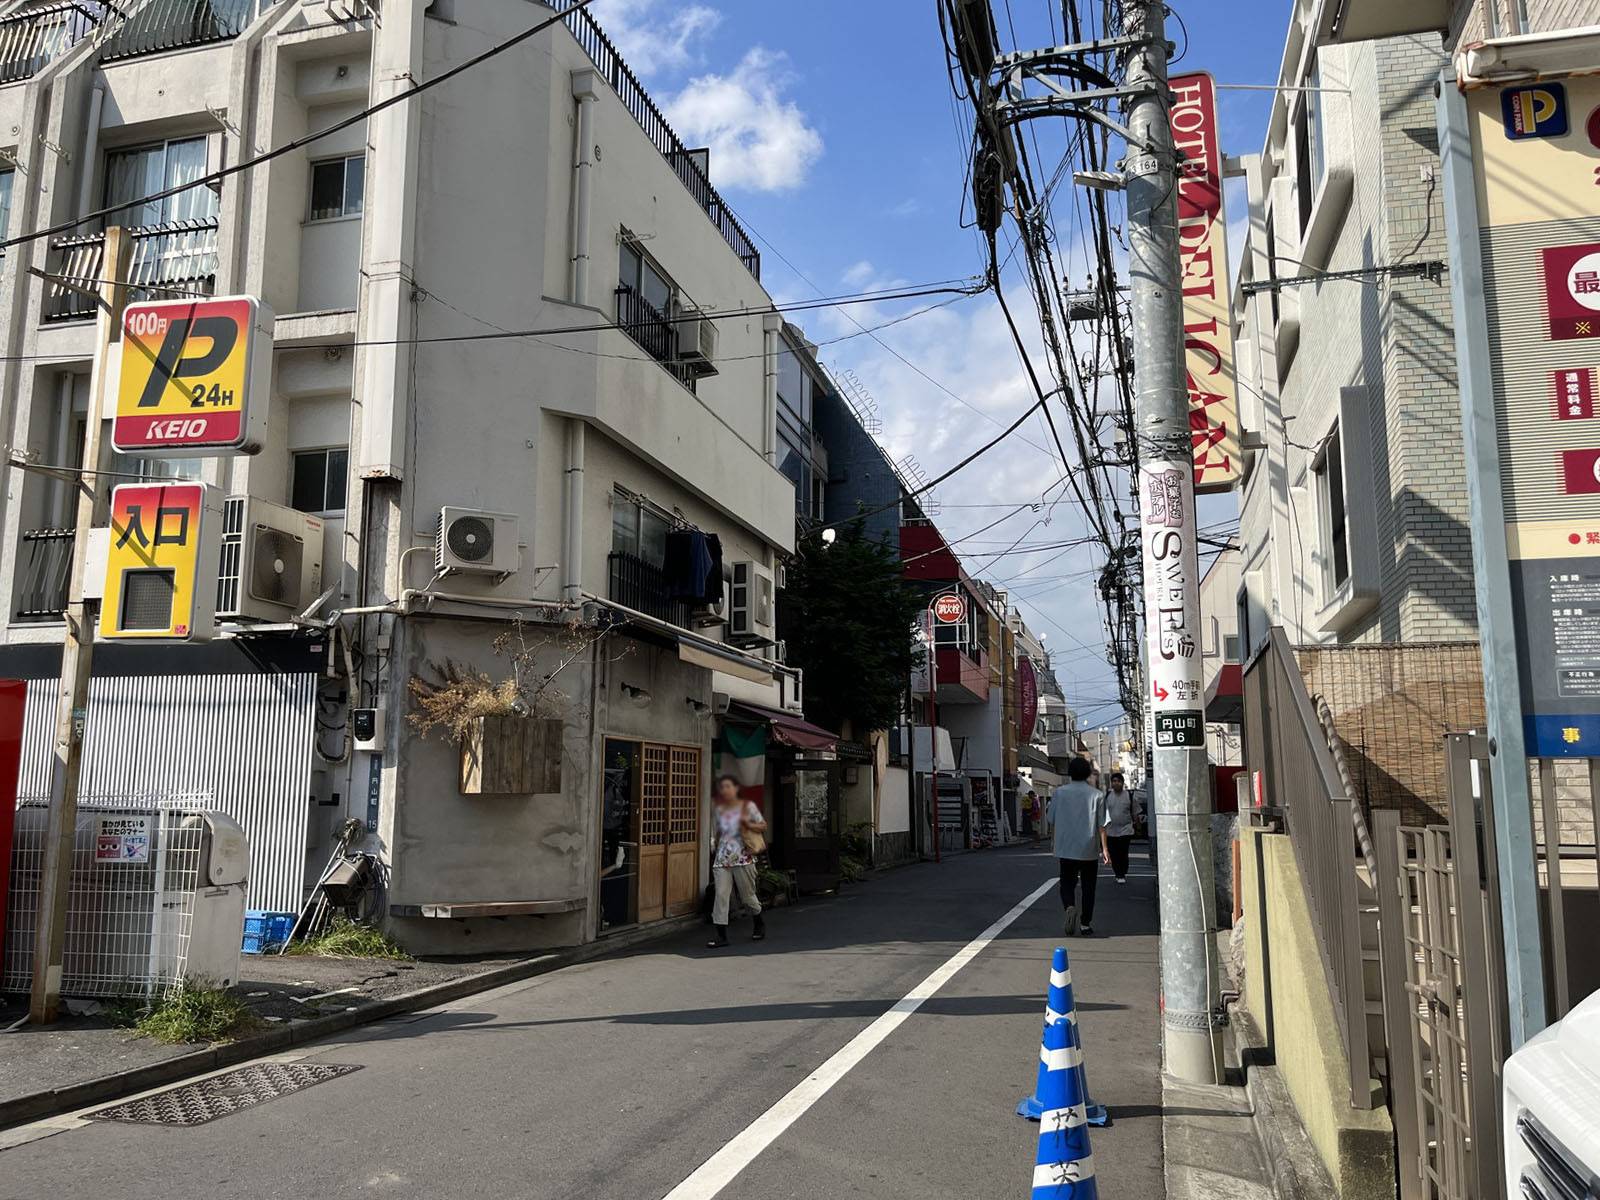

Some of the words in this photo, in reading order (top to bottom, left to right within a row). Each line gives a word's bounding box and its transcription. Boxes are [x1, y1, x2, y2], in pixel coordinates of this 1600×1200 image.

[1512, 95, 1520, 112] COIN
[1513, 113, 1522, 132] PARK
[1169, 81, 1209, 195] HOTEL
[1140, 160, 1157, 171] 164
[128, 312, 167, 337] 100円
[137, 316, 238, 408] P
[190, 383, 234, 408] 24H
[146, 419, 208, 440] KEIO
[1150, 480, 1165, 516] ホテル
[115, 505, 190, 550] 入口
[938, 603, 960, 615] 消火栓
[1162, 717, 1196, 729] 円山町
[1176, 731, 1185, 743] 6
[368, 820, 377, 829] 15
